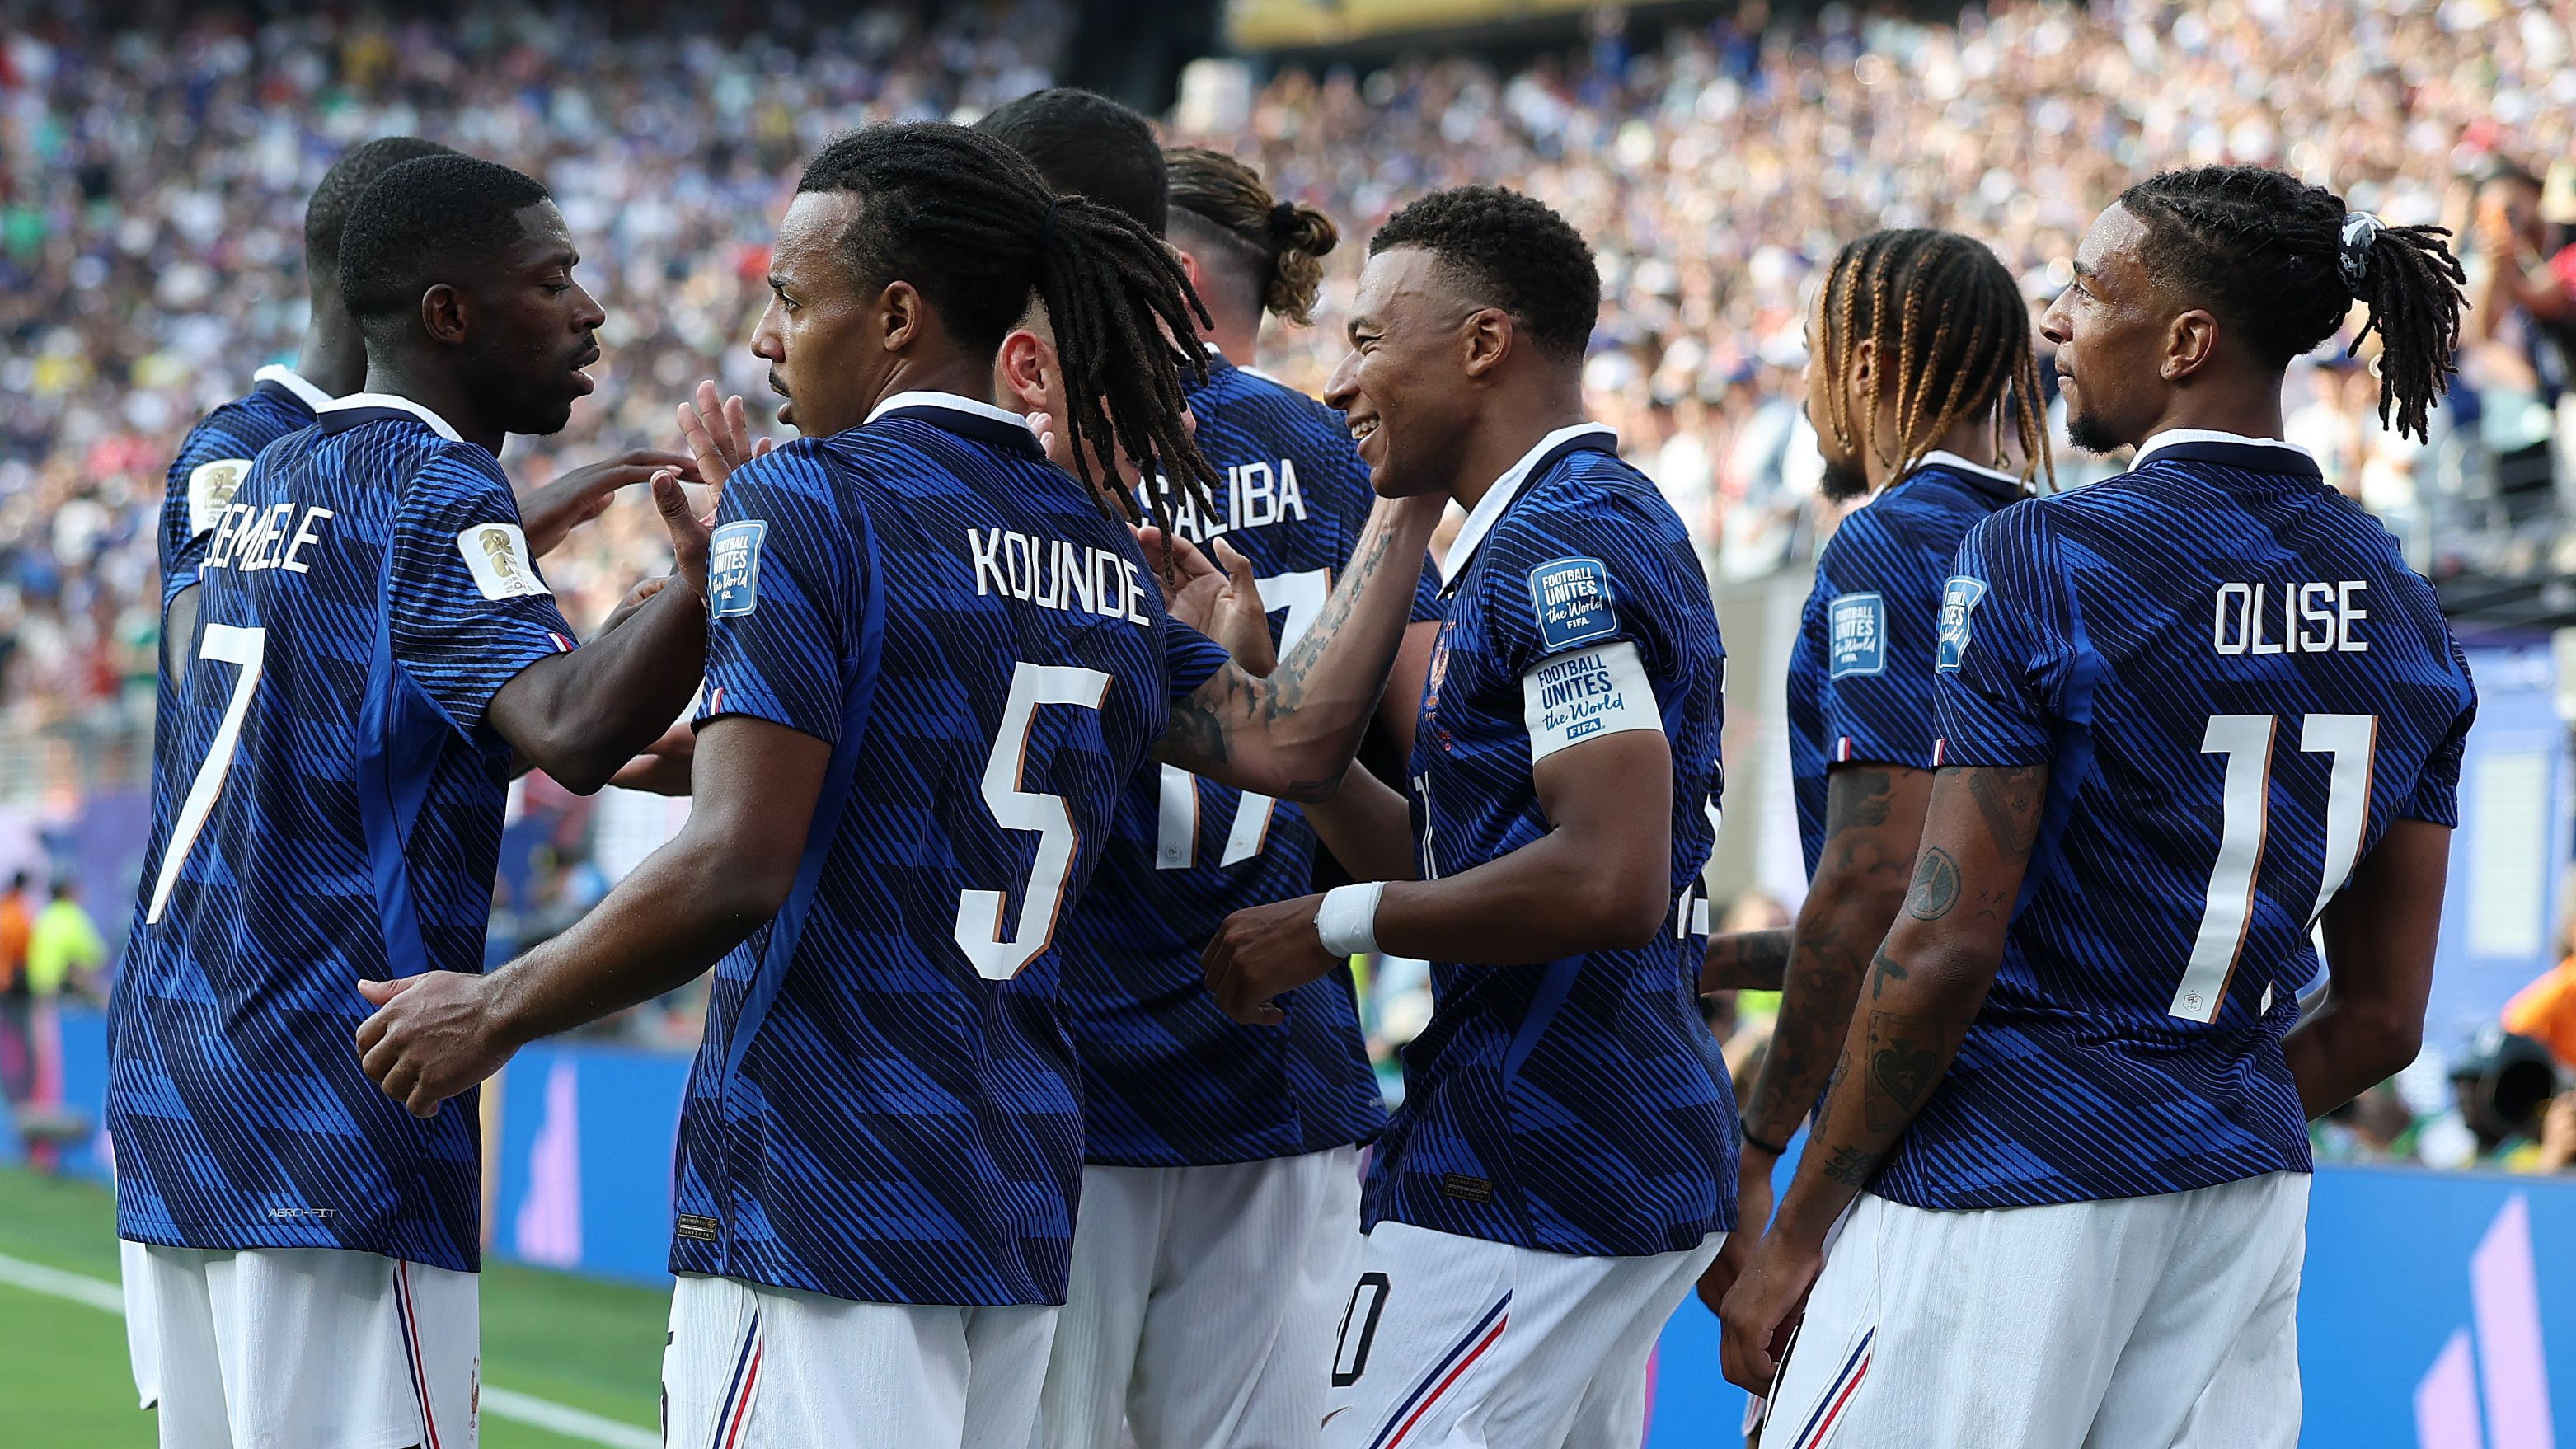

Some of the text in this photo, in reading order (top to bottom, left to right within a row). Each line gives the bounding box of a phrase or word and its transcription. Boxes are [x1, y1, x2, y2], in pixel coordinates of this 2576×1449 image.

[716, 535, 749, 556] FOOTBALL
[713, 550, 748, 575] UNITES
[967, 528, 1150, 626] KOUNDE
[1541, 566, 1595, 590] FOOTBALL
[723, 570, 749, 589] World
[1544, 580, 1598, 607] UNITES
[1546, 595, 1603, 624] the World
[1566, 617, 1589, 630] FIFA
[2214, 580, 2369, 655] OLISE
[1537, 654, 1607, 688] FOOTBALL
[1541, 670, 1613, 710] UNITES
[1542, 692, 1625, 731] the World
[1568, 720, 1600, 738] FIFA
[147, 623, 267, 925] 7
[955, 661, 1113, 981] 5
[2168, 713, 2379, 1025] 11
[268, 1208, 337, 1218] AERO-FIT
[1331, 1272, 1391, 1387] 0
